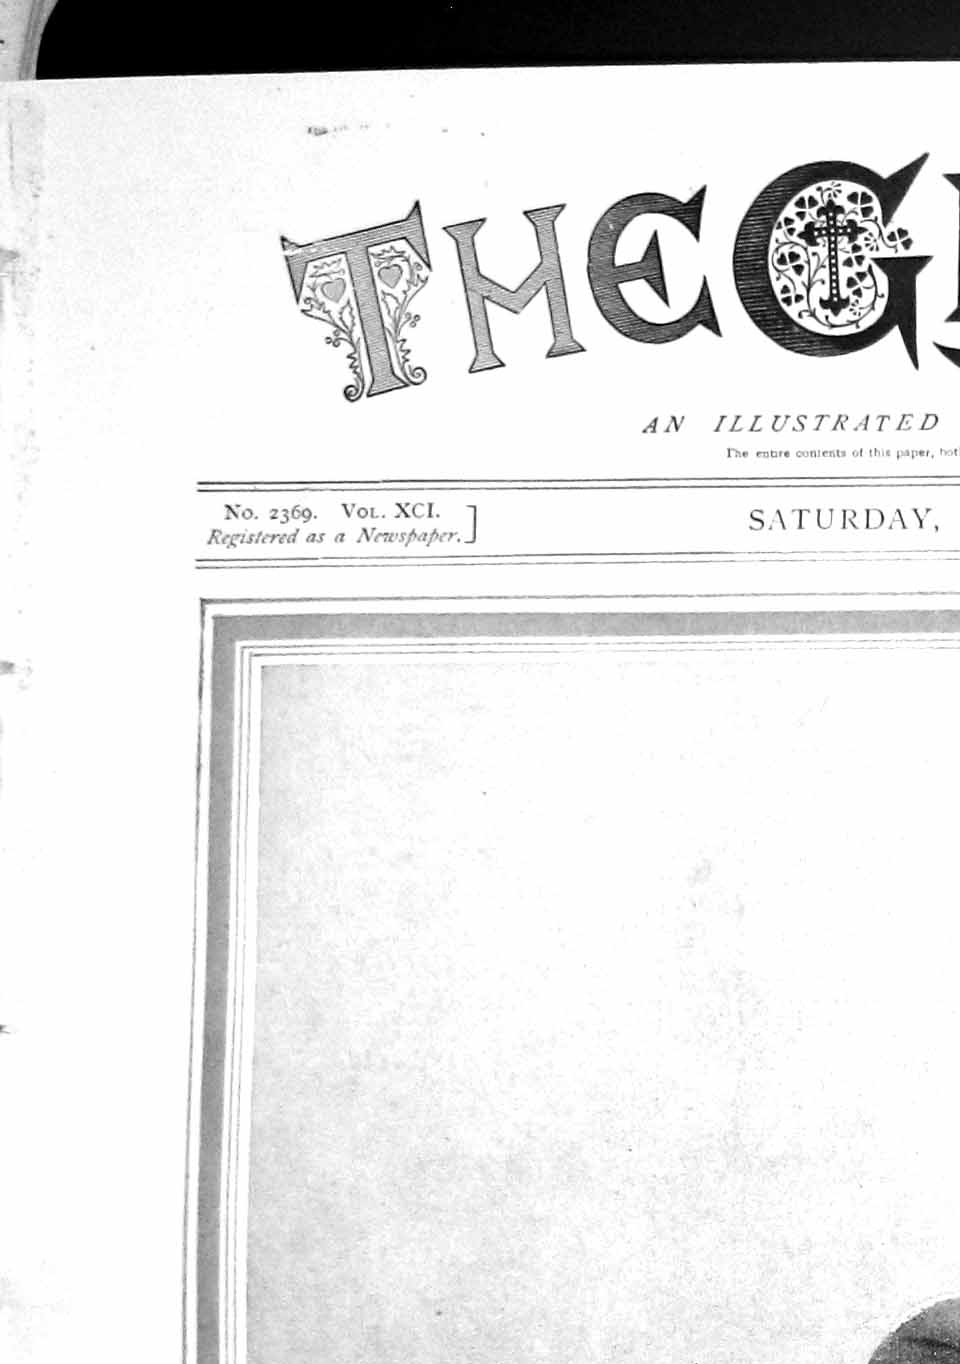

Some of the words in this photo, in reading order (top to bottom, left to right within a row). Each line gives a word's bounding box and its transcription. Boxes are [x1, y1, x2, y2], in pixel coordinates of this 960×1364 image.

[280, 184, 722, 403] THE
[641, 415, 686, 434] AN
[713, 412, 941, 433] ILLUSTRATED
[727, 448, 749, 458] The
[756, 448, 791, 458] entire
[796, 448, 847, 458] contents
[852, 447, 864, 458] of
[869, 447, 891, 457] this
[896, 449, 935, 460] paper,
[269, 504, 318, 524] 2369.
[394, 502, 441, 520] XCI.
[748, 508, 941, 533] SATURDAY,
[206, 527, 300, 549] Registered
[306, 532, 326, 545] as
[333, 532, 346, 544] a
[355, 526, 462, 547] Newspaper.
